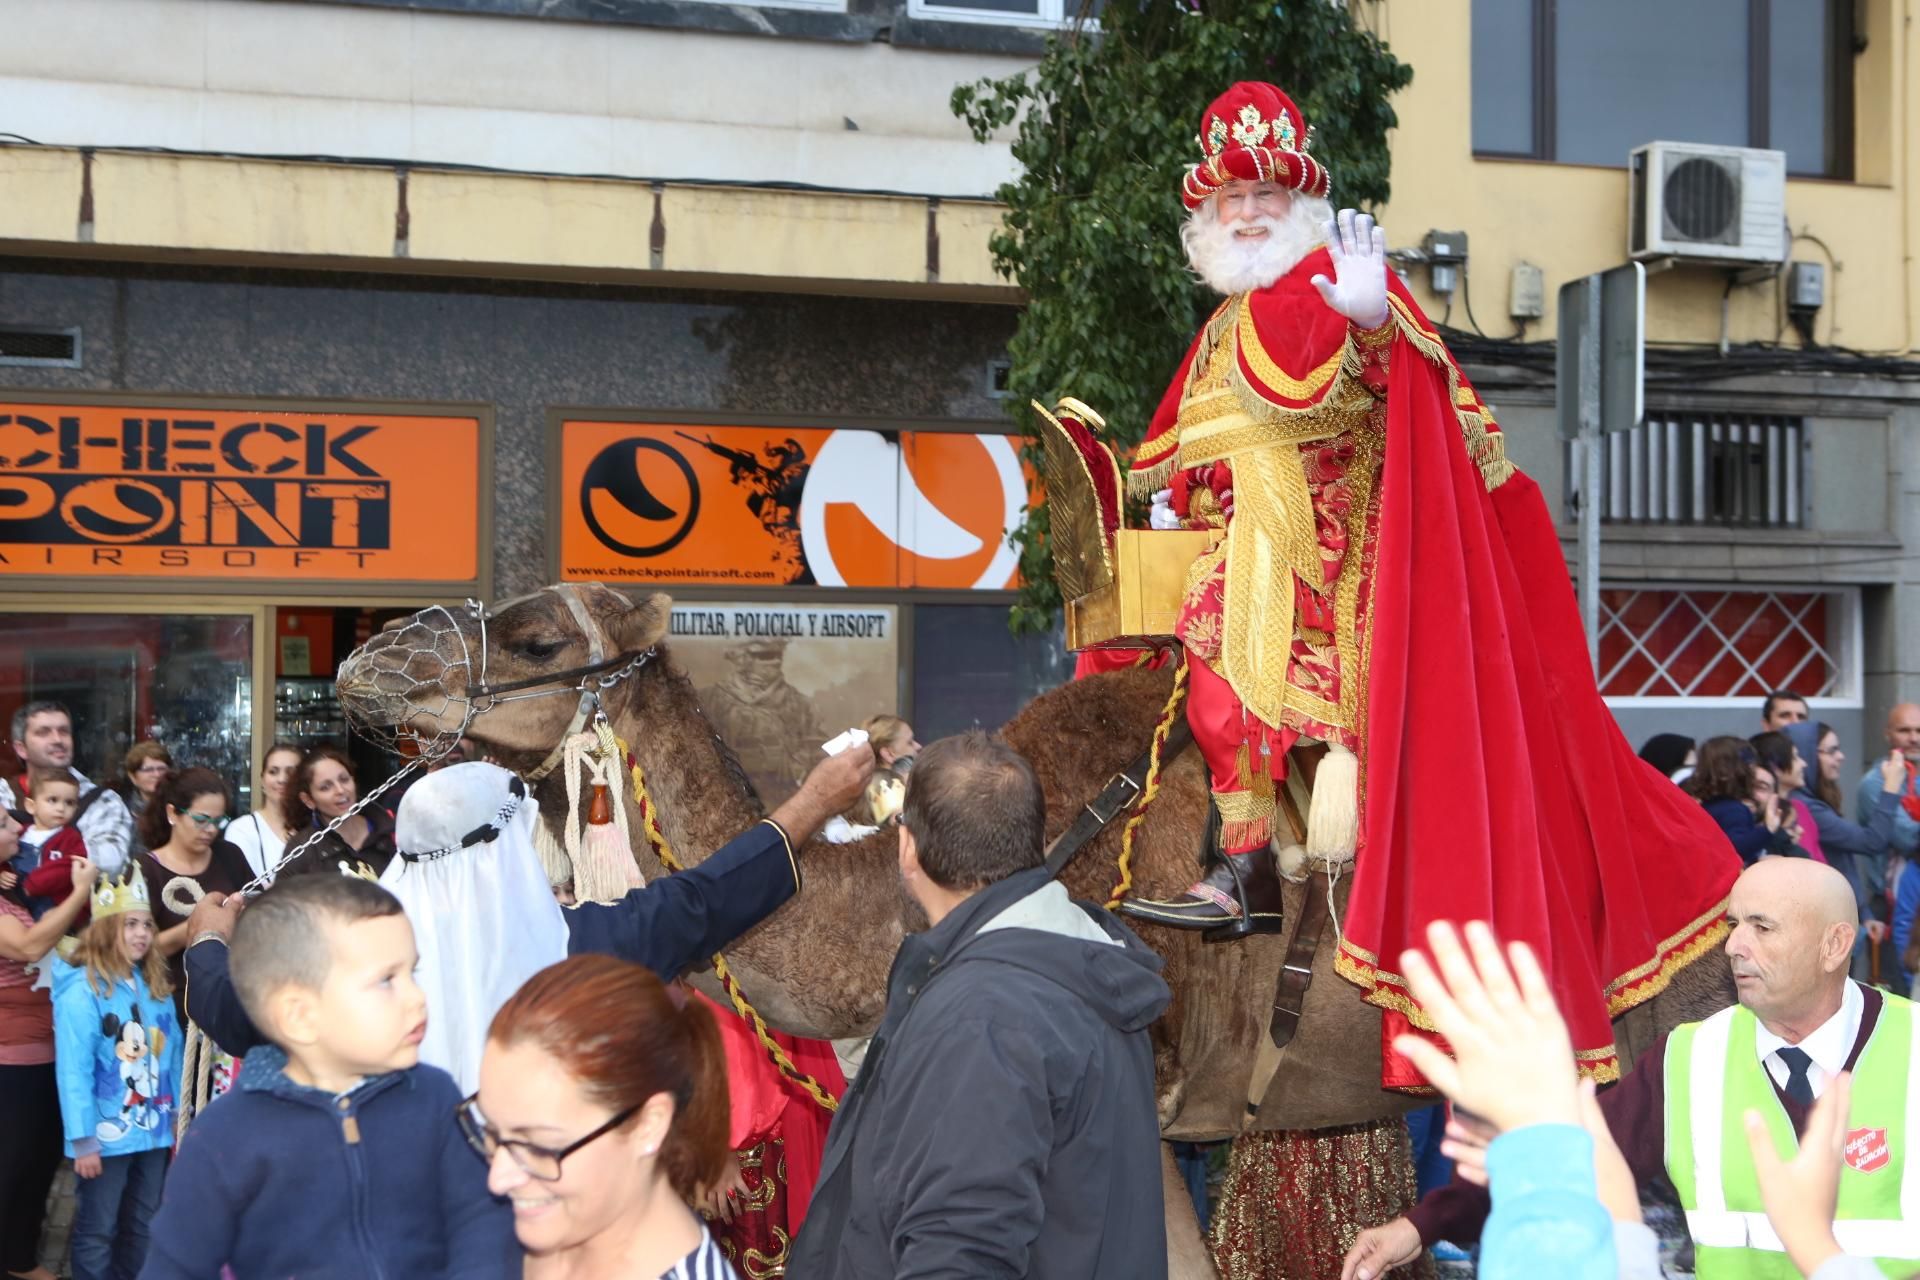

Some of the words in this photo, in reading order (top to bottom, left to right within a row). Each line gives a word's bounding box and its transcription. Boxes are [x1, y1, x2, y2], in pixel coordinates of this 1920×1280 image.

[0, 415, 382, 477] CHECK
[0, 547, 376, 568] IRSOFT
[567, 566, 775, 579] www.checkpointairsoft.com
[671, 612, 730, 639] ILITAR,
[734, 612, 803, 637] POLICIAL
[808, 613, 818, 637] Y
[820, 613, 885, 638] AIRSOFT
